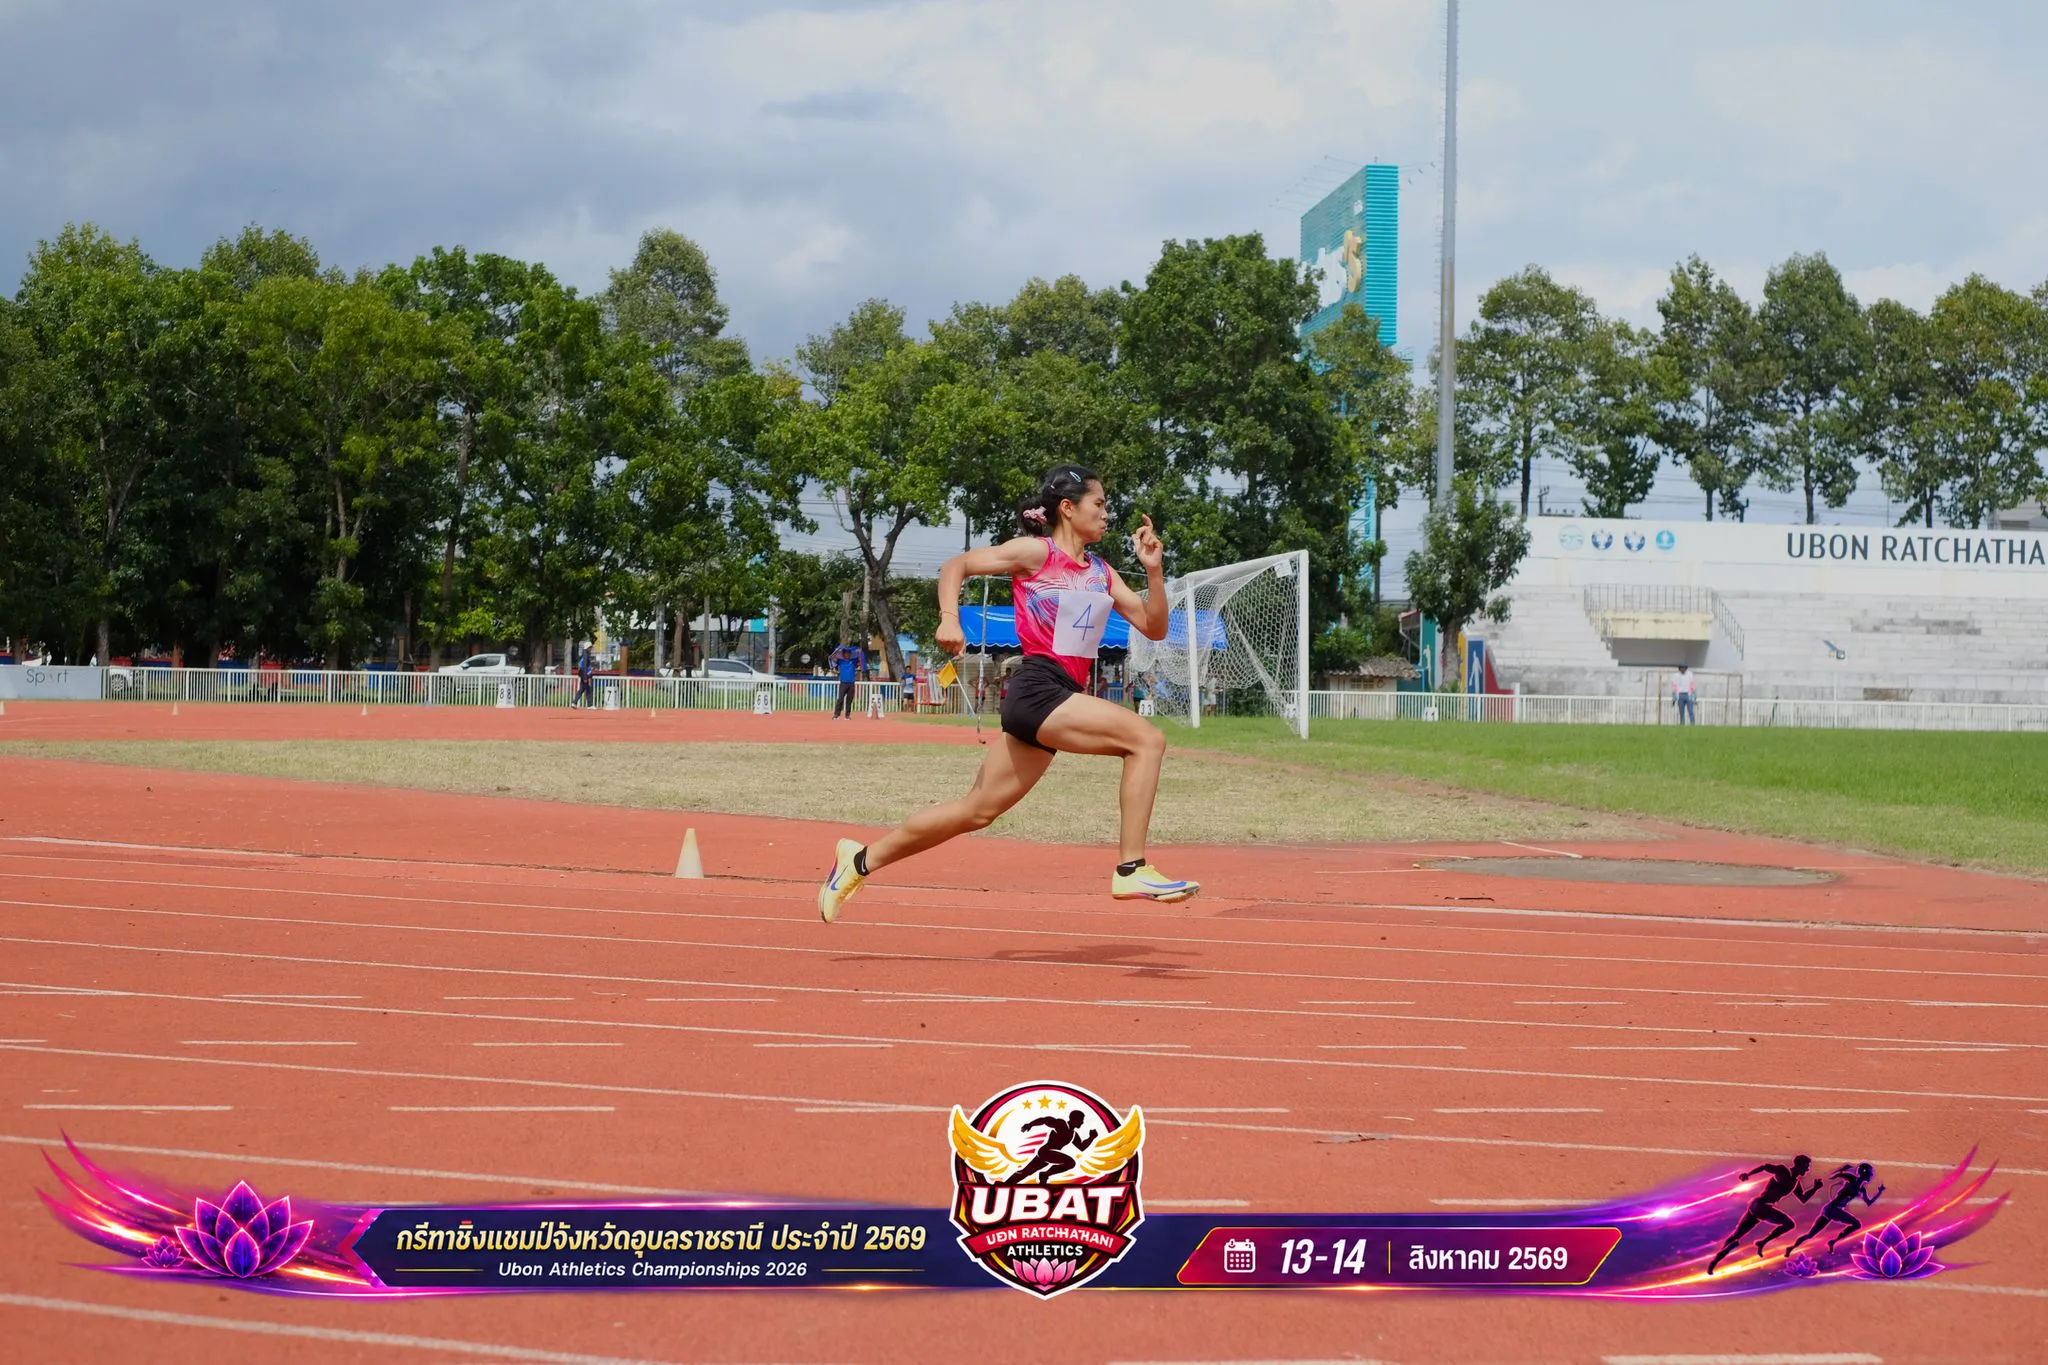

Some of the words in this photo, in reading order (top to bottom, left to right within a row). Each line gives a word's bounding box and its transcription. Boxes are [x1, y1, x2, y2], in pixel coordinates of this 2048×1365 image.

[1787, 532, 1868, 560] UBON
[1881, 535, 2046, 565] RATCHATHA
[1072, 603, 1095, 641] 4
